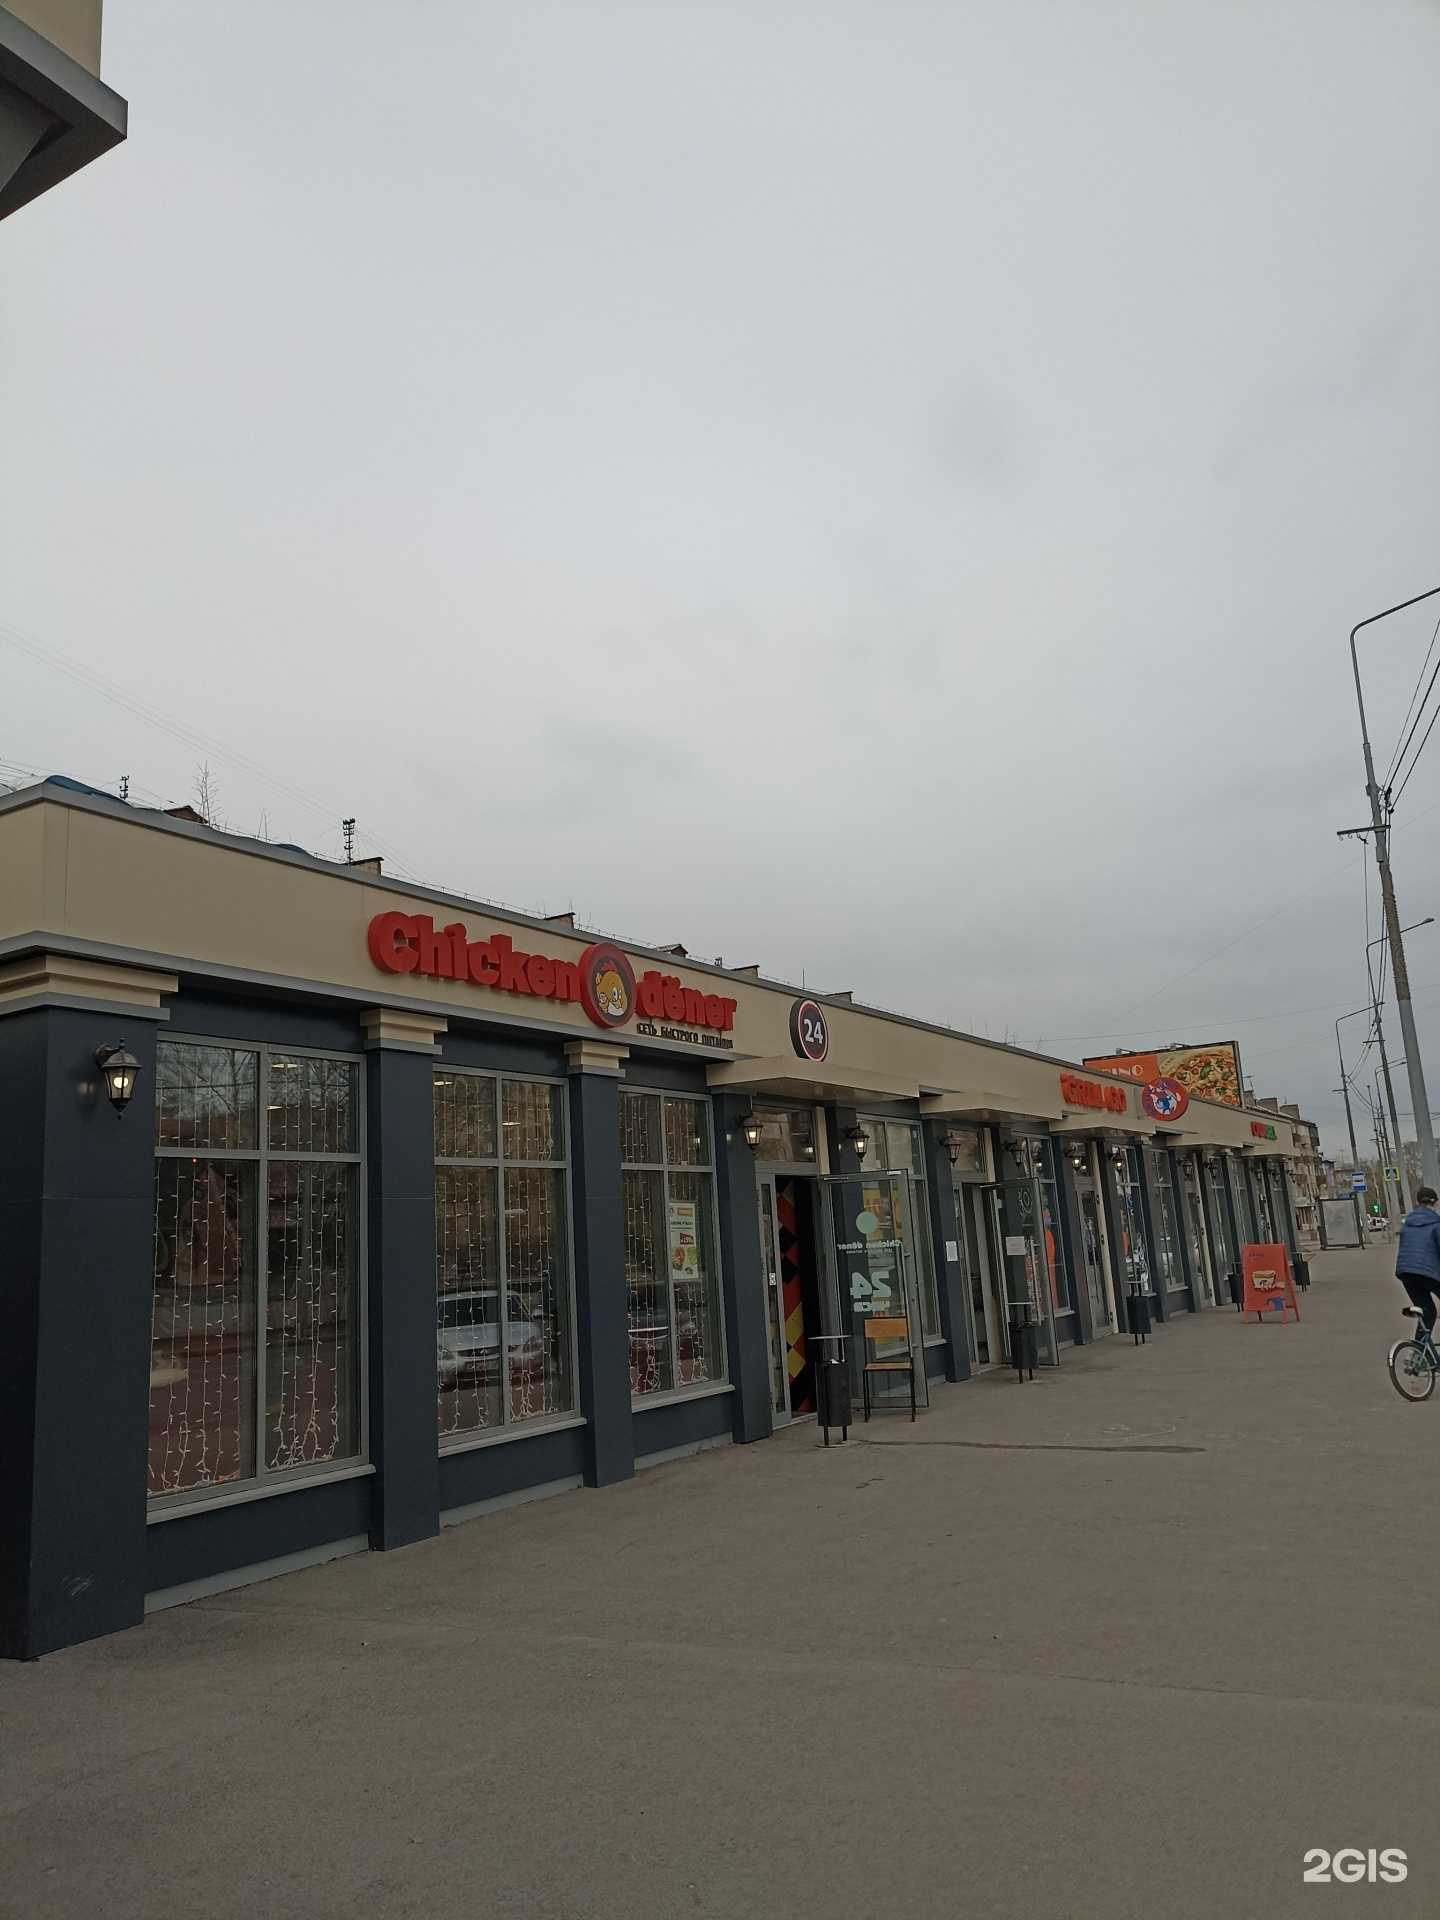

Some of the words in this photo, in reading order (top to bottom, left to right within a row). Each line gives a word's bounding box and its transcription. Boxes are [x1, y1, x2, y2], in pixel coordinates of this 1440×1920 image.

[368, 911, 582, 1003] Chicken
[636, 1022, 657, 1036] СЕТЬ
[660, 1026, 699, 1044] БЫСТРОГО
[803, 1018, 824, 1045] 24
